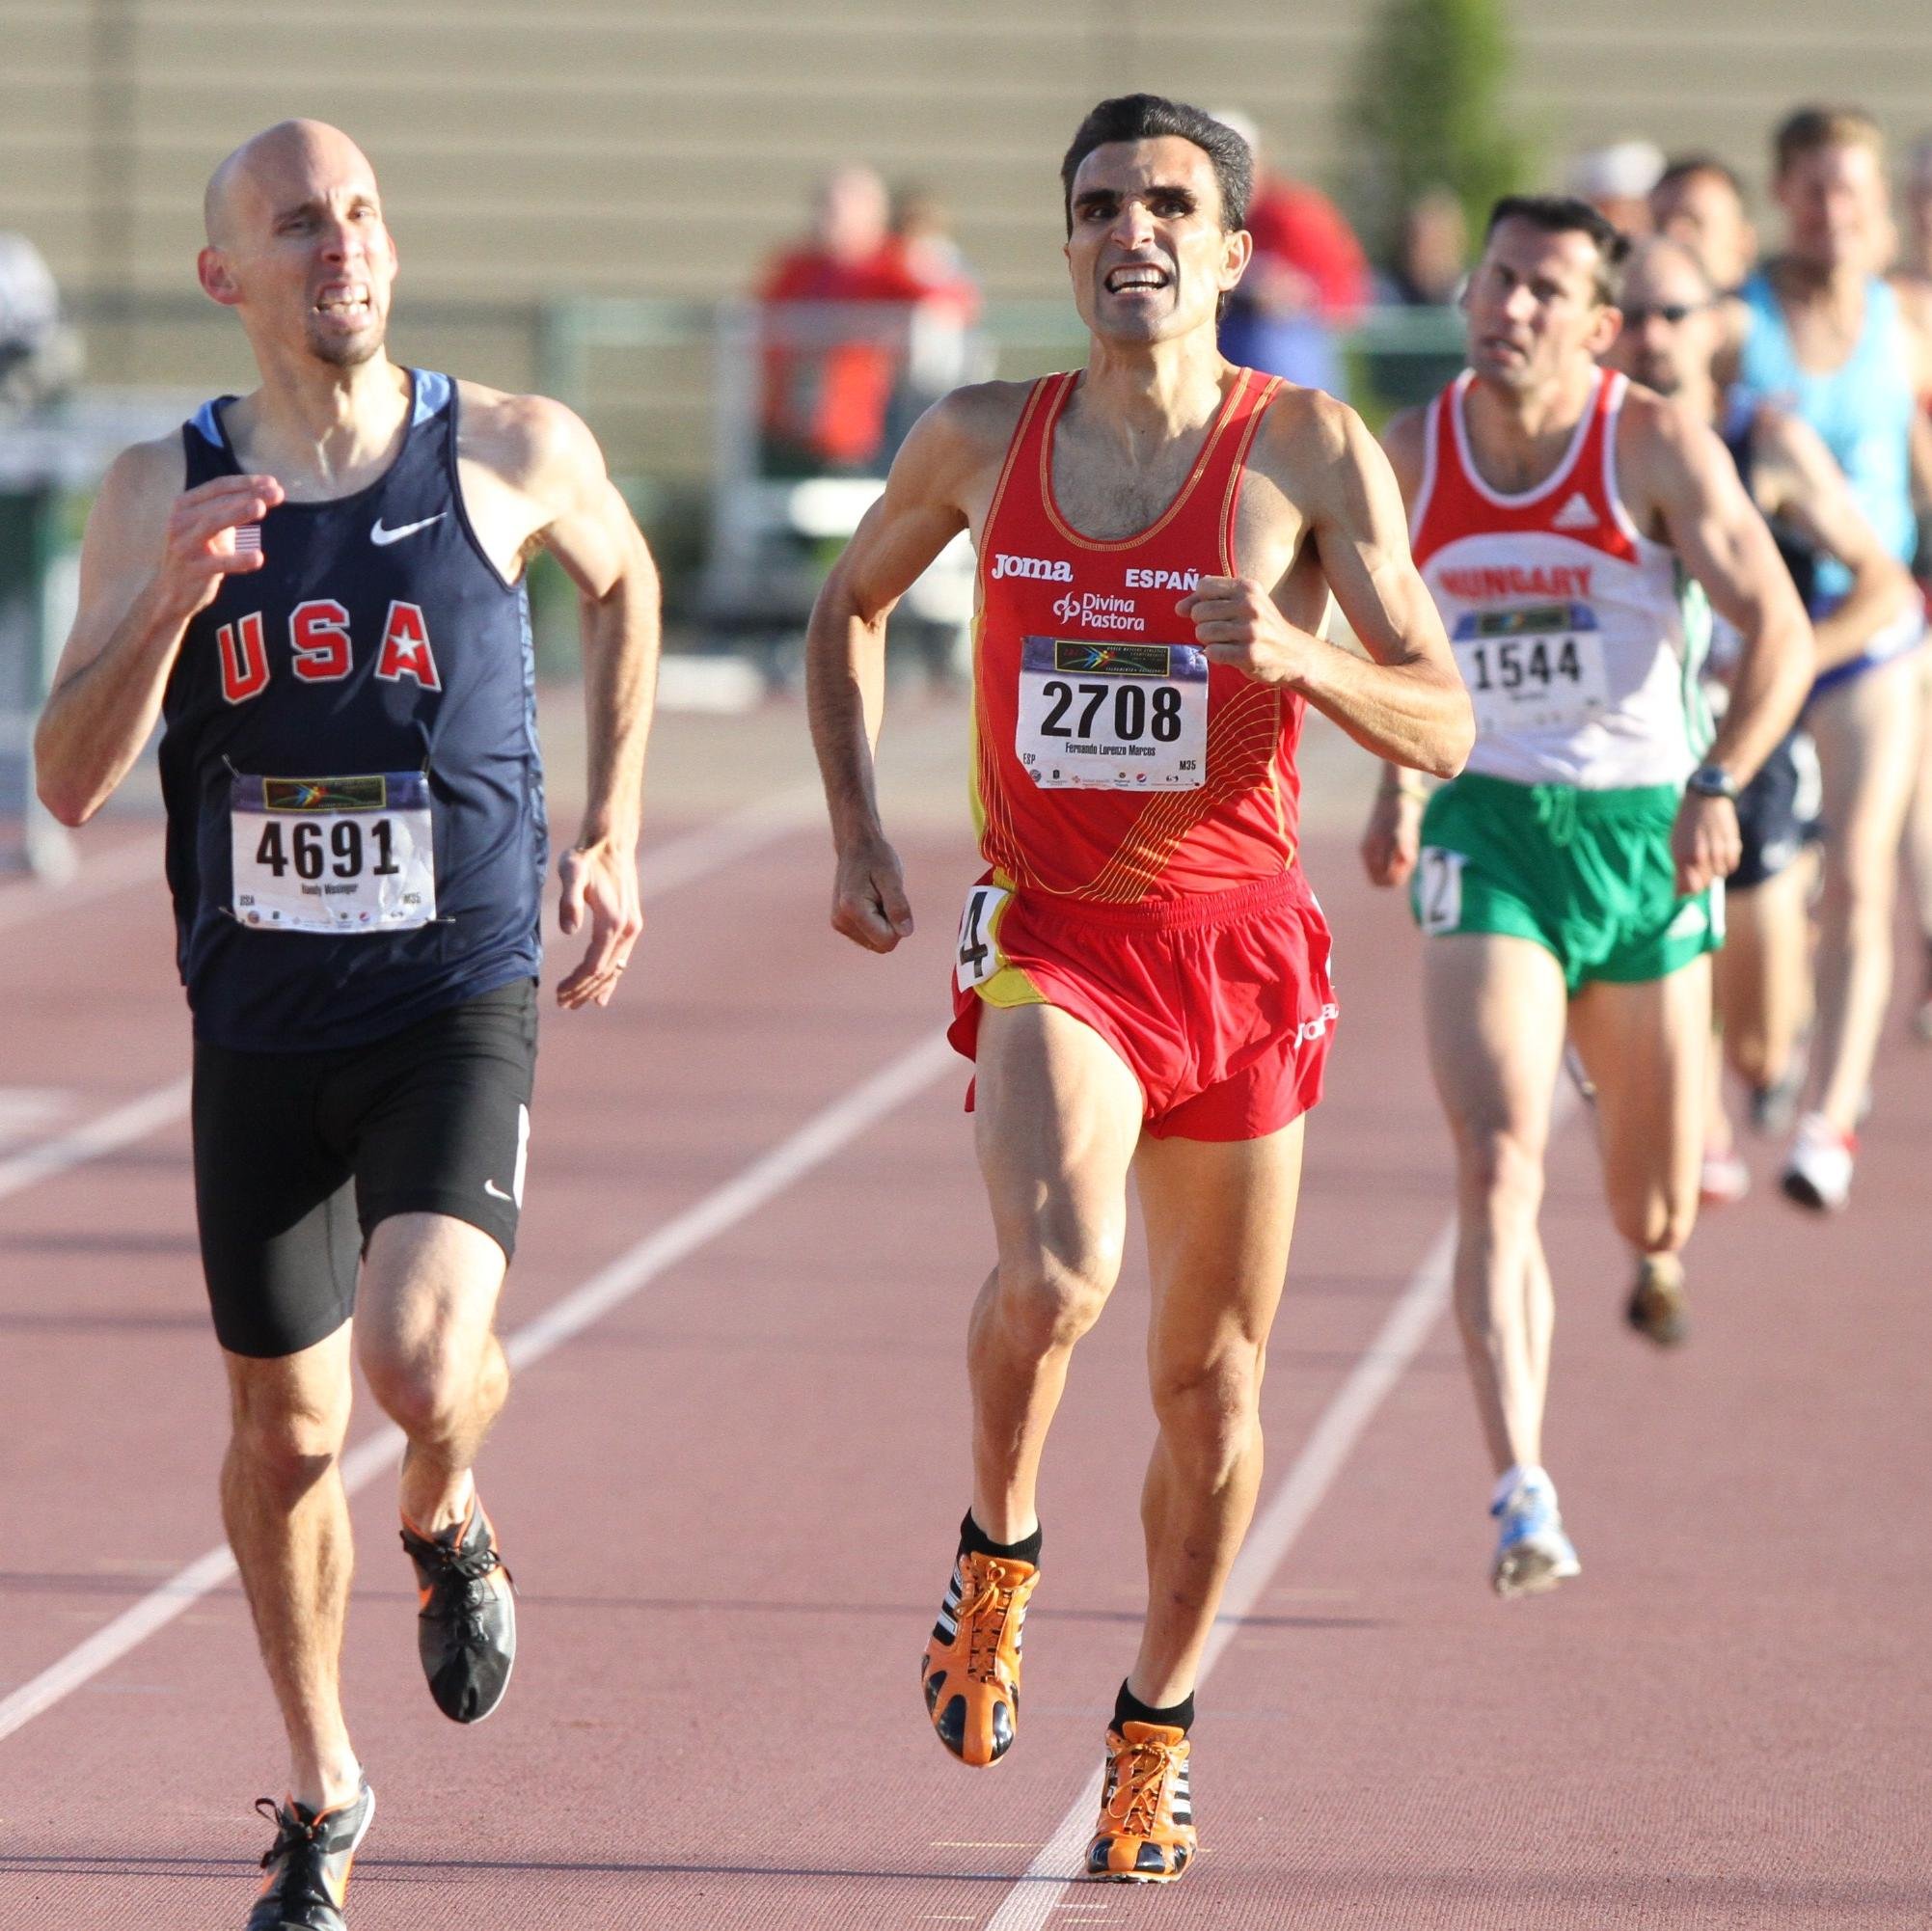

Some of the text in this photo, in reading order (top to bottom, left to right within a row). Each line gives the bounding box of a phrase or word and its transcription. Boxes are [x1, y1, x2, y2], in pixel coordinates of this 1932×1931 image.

[991, 554, 1074, 583] Joma
[1125, 567, 1208, 591] ESPAÑ
[1438, 565, 1593, 602] HUNGARY
[1082, 592, 1135, 612] Divina
[1081, 610, 1145, 632] Pastora
[215, 598, 443, 705] USA
[1473, 637, 1582, 690] 1544
[1040, 680, 1183, 742] 2708
[1022, 752, 1036, 765] ESP
[1065, 742, 1156, 757] Fernando Lorenzo Marcos
[1180, 760, 1197, 772] M35
[256, 818, 399, 880] 4691
[960, 891, 989, 978] 4
